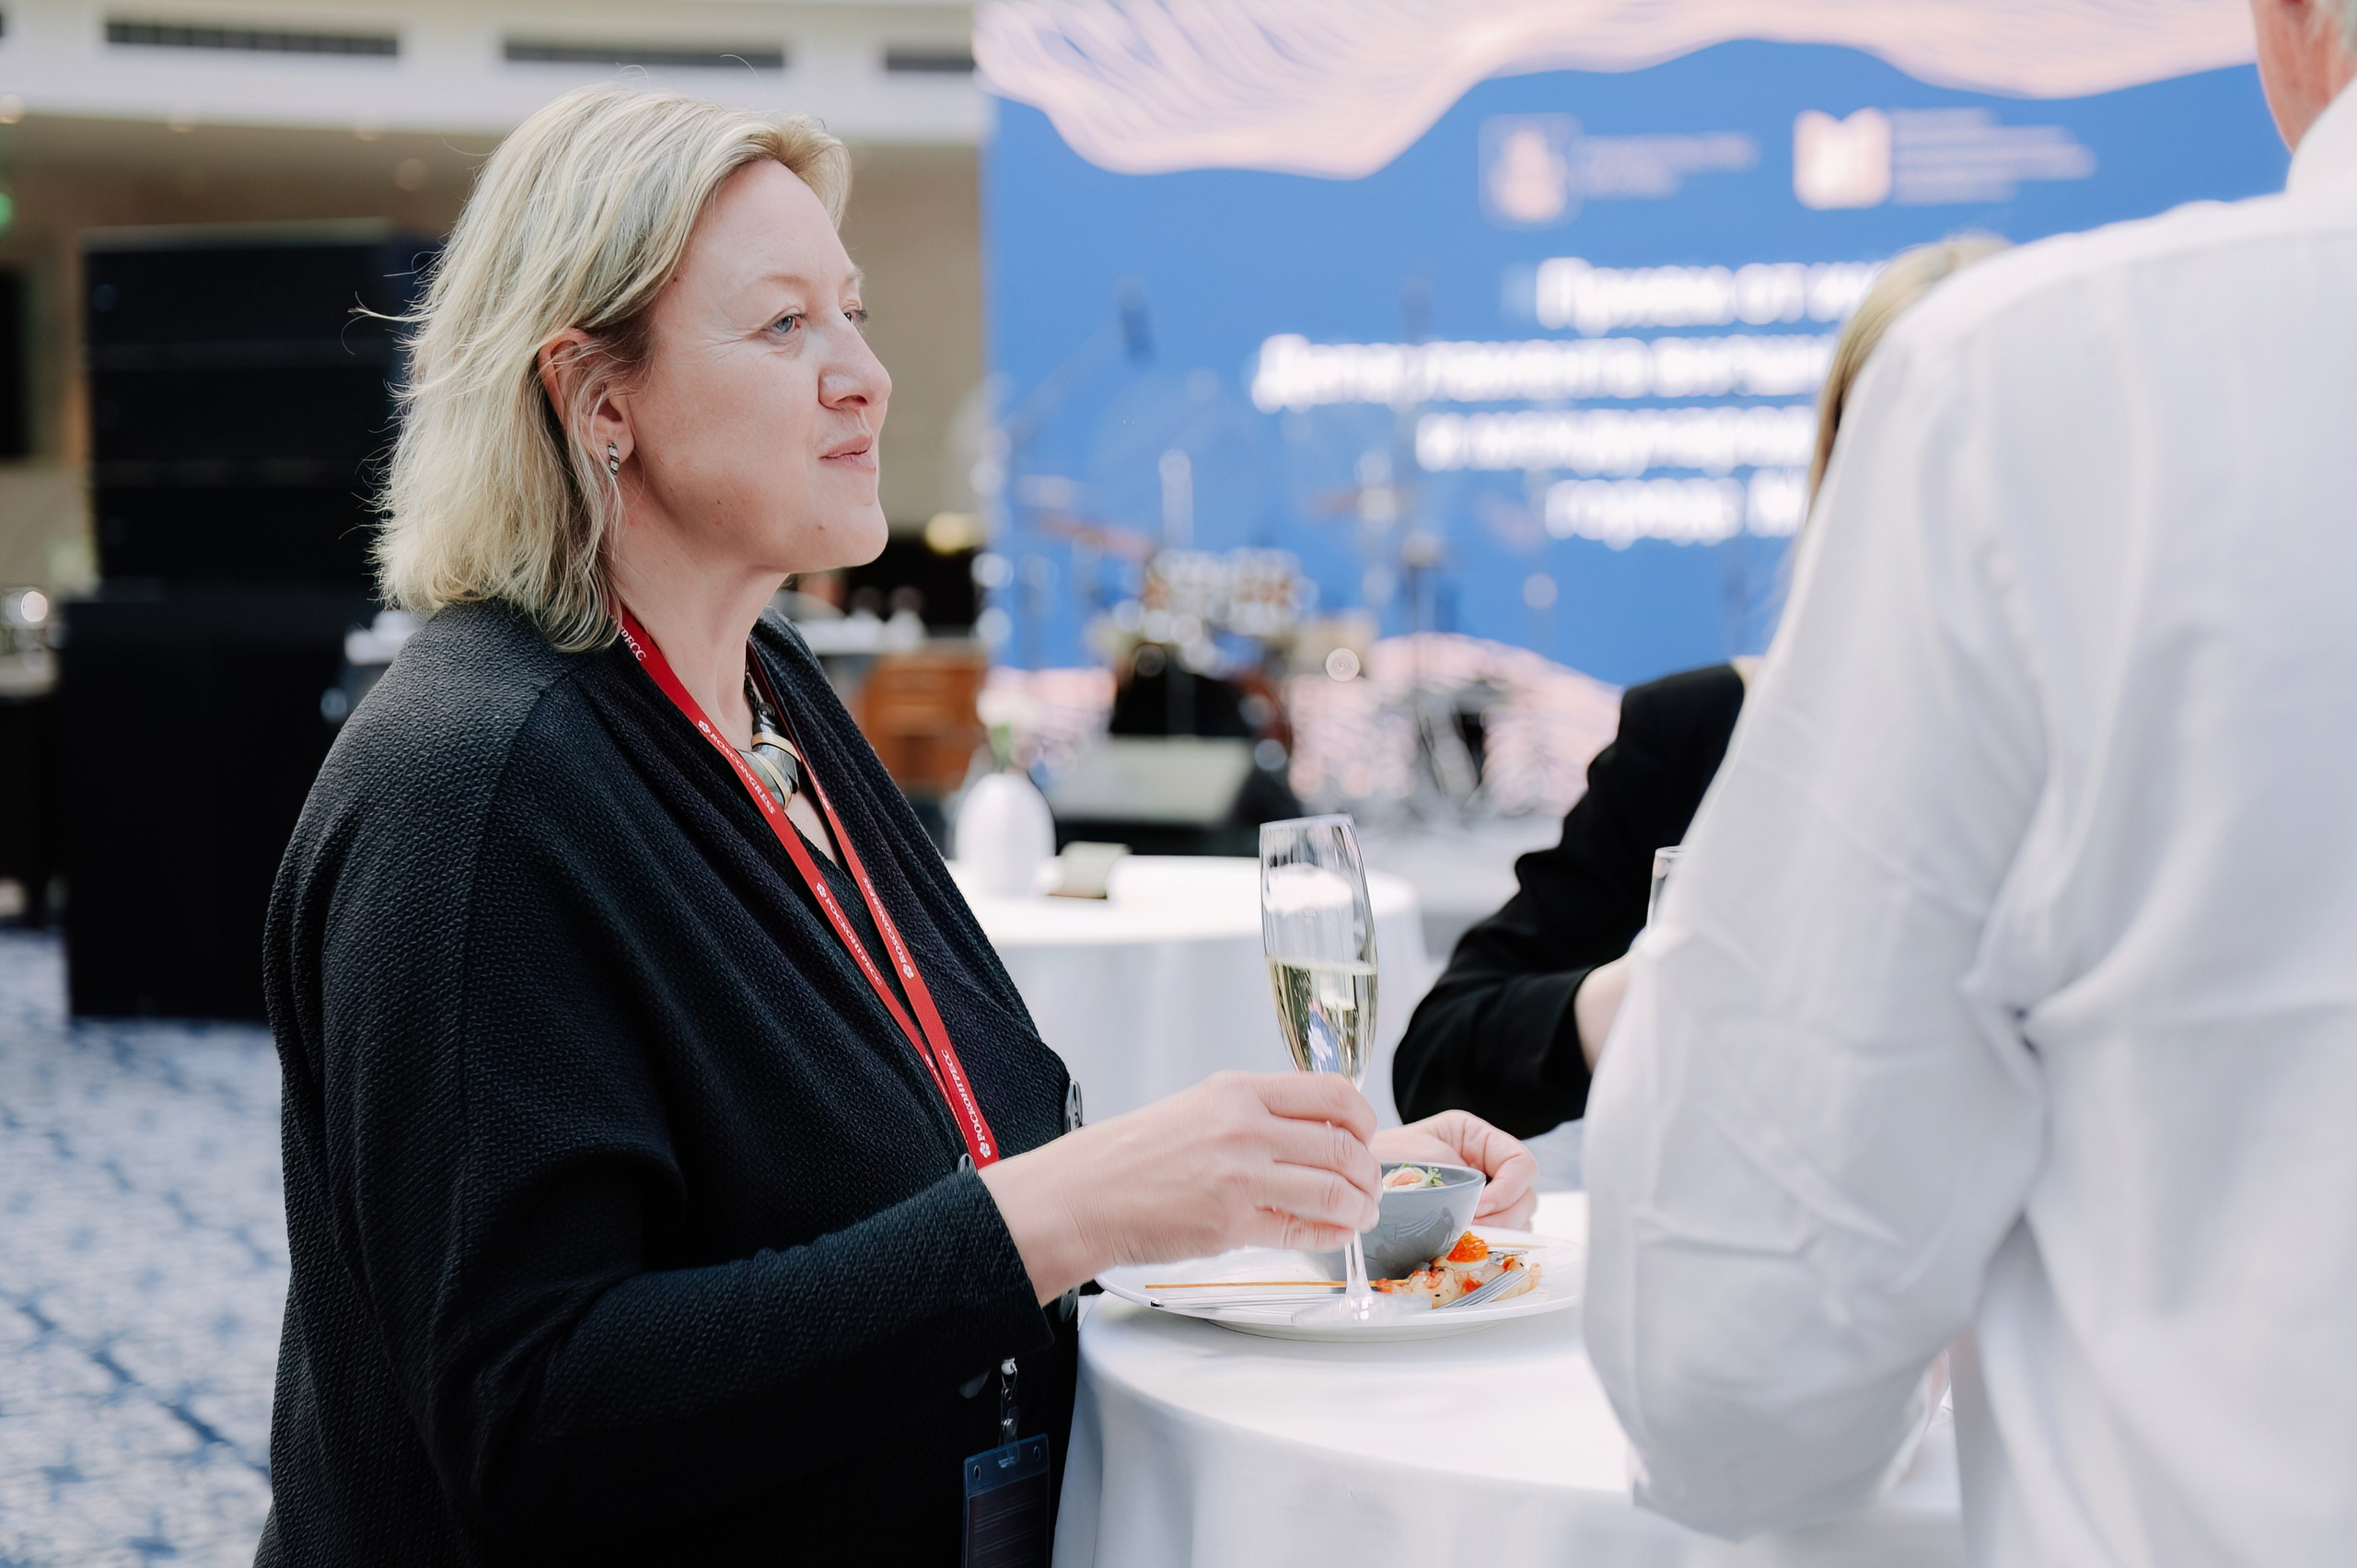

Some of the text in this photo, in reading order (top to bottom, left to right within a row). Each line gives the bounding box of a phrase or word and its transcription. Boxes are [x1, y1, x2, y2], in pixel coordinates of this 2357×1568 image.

[710, 733, 775, 814] ROSCONGRESS
[825, 897, 883, 986] РОСКОНГРЕСС
[941, 1049, 986, 1142] РОСКОНГРЕСС
